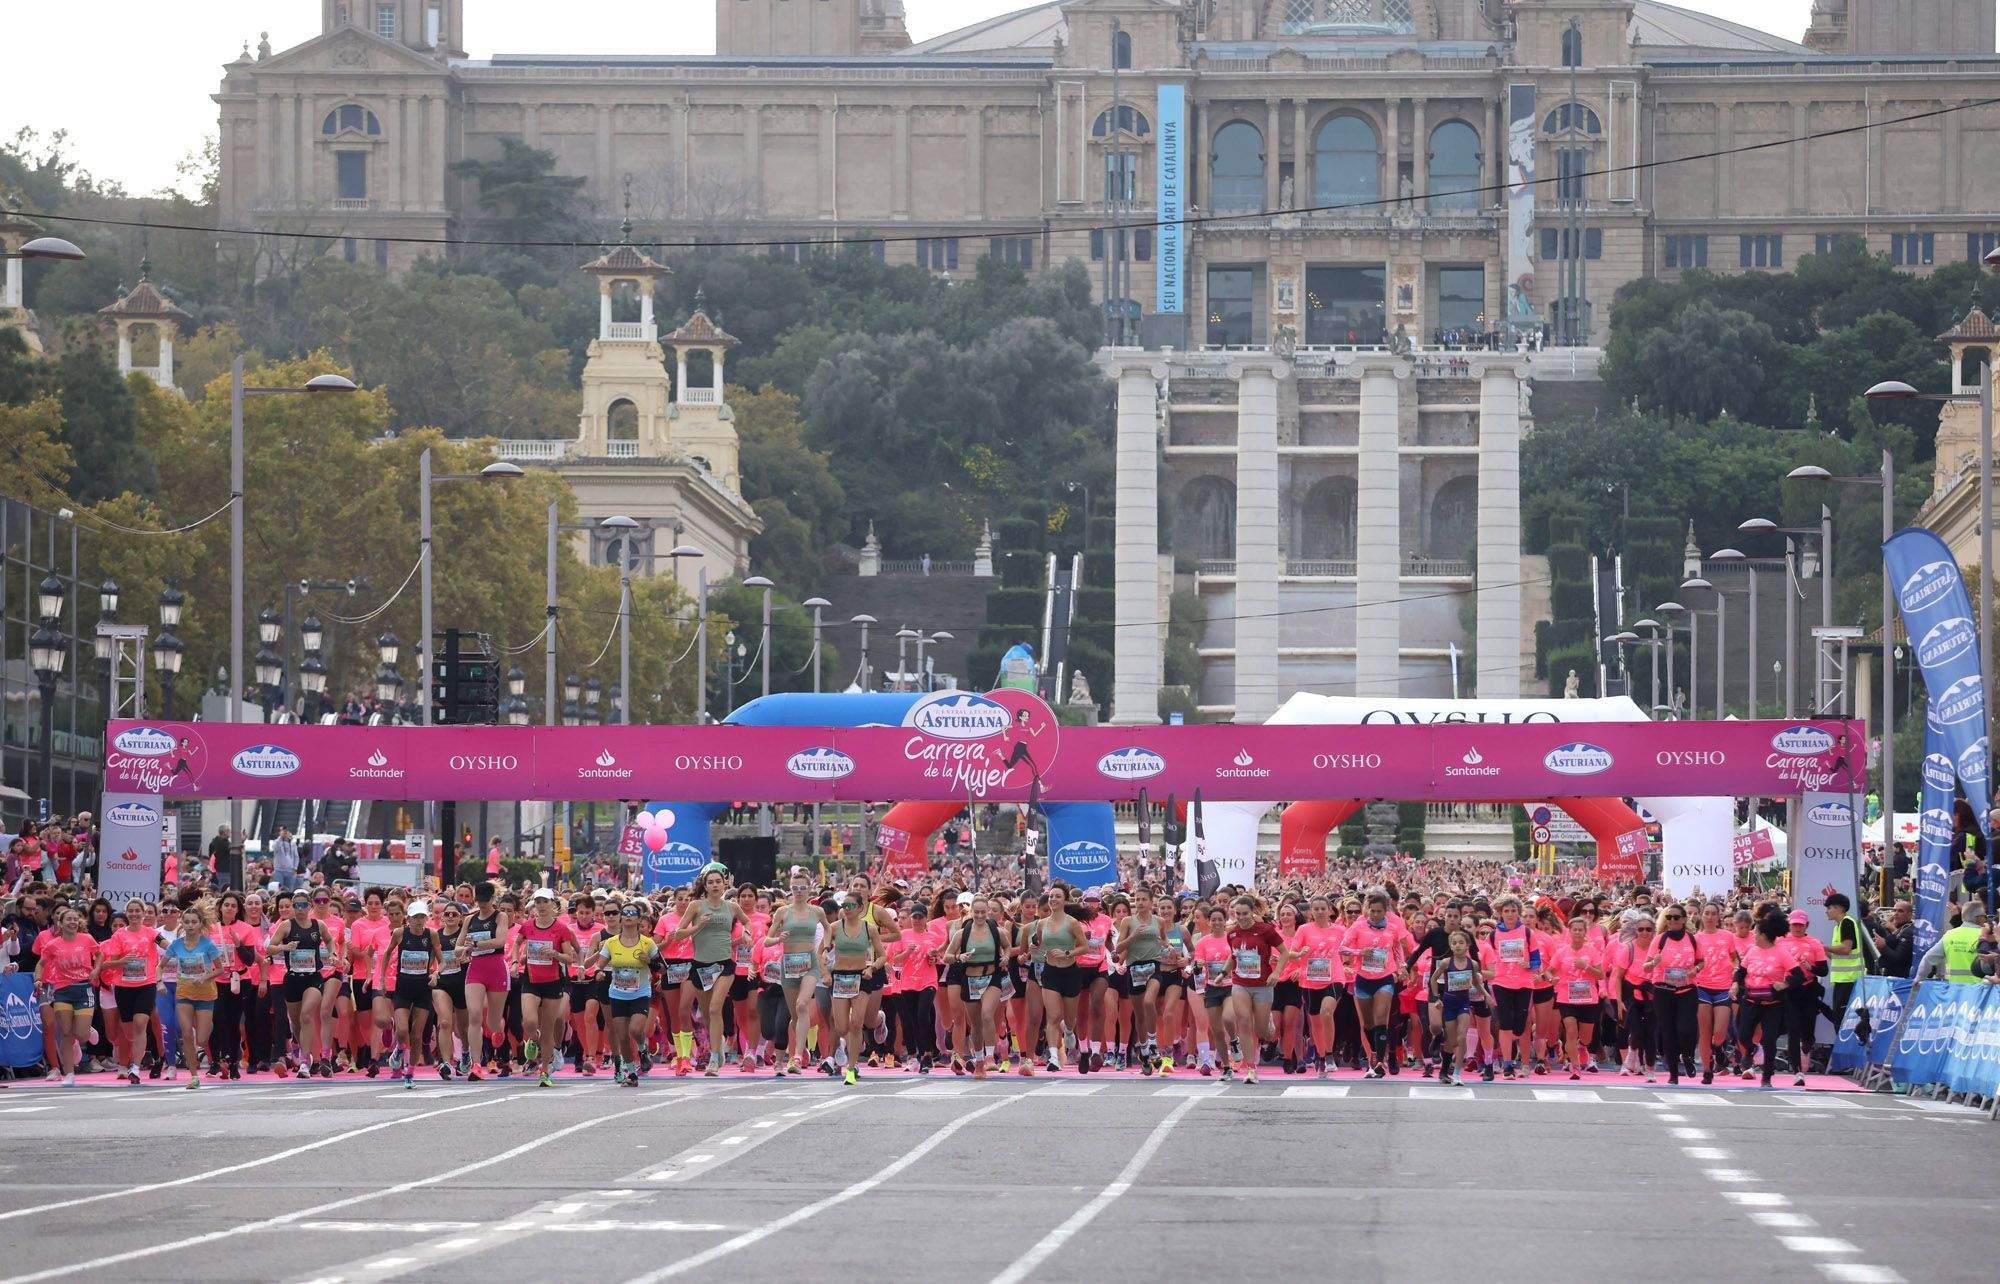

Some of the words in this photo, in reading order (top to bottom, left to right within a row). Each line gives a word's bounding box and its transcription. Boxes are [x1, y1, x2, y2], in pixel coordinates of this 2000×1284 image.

[1164, 121, 1176, 180] CATALUNYA
[1164, 184, 1176, 196] DE
[1164, 235, 1176, 287] NACIONAL
[1164, 291, 1176, 313] SEU
[921, 710, 1003, 728] ASTURIANA
[119, 737, 172, 749] ASTURIANA
[904, 736, 986, 761] Carrera
[1777, 736, 1830, 748] ASTURIANA
[107, 753, 161, 769] Carrera
[237, 756, 295, 769] ASTURIANA
[450, 755, 517, 770] OYSHO
[675, 755, 743, 770] OYSHO
[1313, 754, 1381, 768] OYSHO
[1550, 755, 1608, 767] ASTURIANA
[1657, 751, 1725, 765] OYSHO
[1765, 753, 1818, 768] Carrera
[792, 758, 850, 772] ASTURIANA
[1102, 759, 1160, 771] ASTURIANA
[1446, 766, 1500, 776] Santander
[350, 768, 404, 778] Santander
[578, 767, 632, 778] Santander
[924, 761, 939, 778] de
[942, 761, 953, 778] la
[951, 757, 1015, 797] Mujer
[1216, 767, 1270, 778] Santander
[1778, 770, 1789, 780] de
[1796, 767, 1837, 791] Mujer
[119, 769, 129, 780] de
[131, 769, 139, 780] la
[136, 768, 178, 793] Mujer
[110, 811, 155, 822] ASTURIANA
[1810, 810, 1852, 822] ASTURIAN
[1536, 831, 1547, 839] 30
[106, 861, 152, 871] Santander
[651, 854, 701, 868] ASTURIANA
[1058, 853, 1109, 866] ASTURIANA
[1673, 864, 1725, 877] OYSHO
